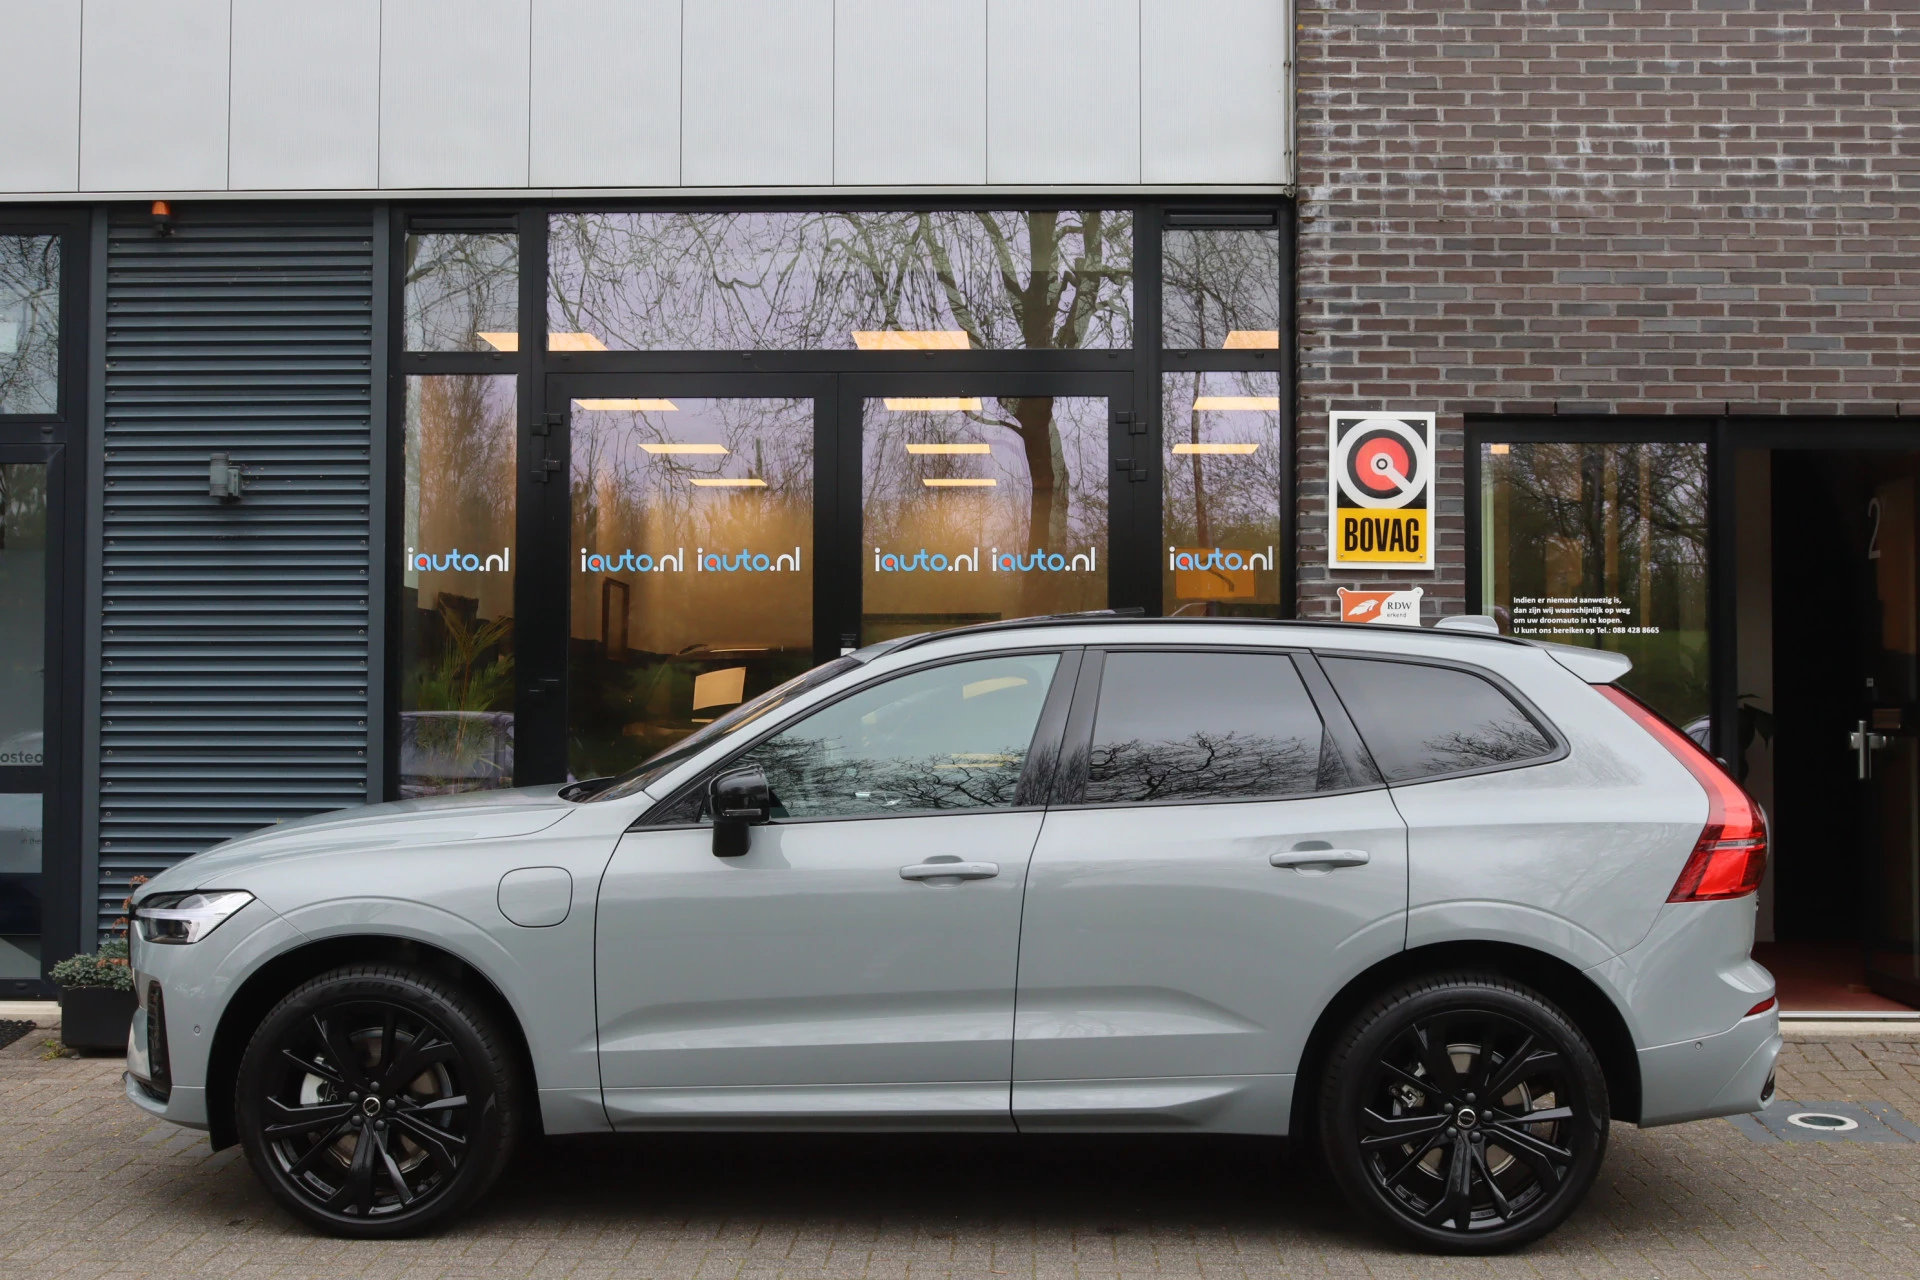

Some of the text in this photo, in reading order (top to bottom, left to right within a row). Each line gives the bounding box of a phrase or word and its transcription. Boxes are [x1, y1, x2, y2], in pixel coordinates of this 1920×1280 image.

[1344, 517, 1419, 552] BOVAG
[407, 547, 509, 572] iauto.nl
[581, 547, 684, 572] iauto.nl
[697, 547, 800, 572] iauto.nl
[874, 547, 979, 572] iauto.nl
[991, 546, 1096, 572] iauto.nl
[1169, 545, 1273, 571] iauto.nl
[1387, 601, 1412, 610] RDW
[1513, 596, 1536, 604] Indien
[1546, 596, 1578, 604] niemand
[1579, 596, 1612, 605] aanwezig
[1613, 596, 1622, 605] is,
[1513, 606, 1527, 614] dan
[1528, 606, 1541, 615] zijn
[1542, 606, 1554, 615] wij
[1554, 606, 1604, 615] waarschijnlijk
[1513, 626, 1520, 634] U
[1521, 626, 1538, 634] kunt
[1553, 626, 1584, 634] bereiken
[1596, 626, 1612, 634] Tel.:
[1612, 626, 1626, 634] 088
[1627, 626, 1641, 634] 428
[1641, 626, 1660, 634] 8665
[1539, 616, 1580, 624] droomauto
[1580, 616, 1588, 624] in
[1598, 616, 1623, 625] kopen.
